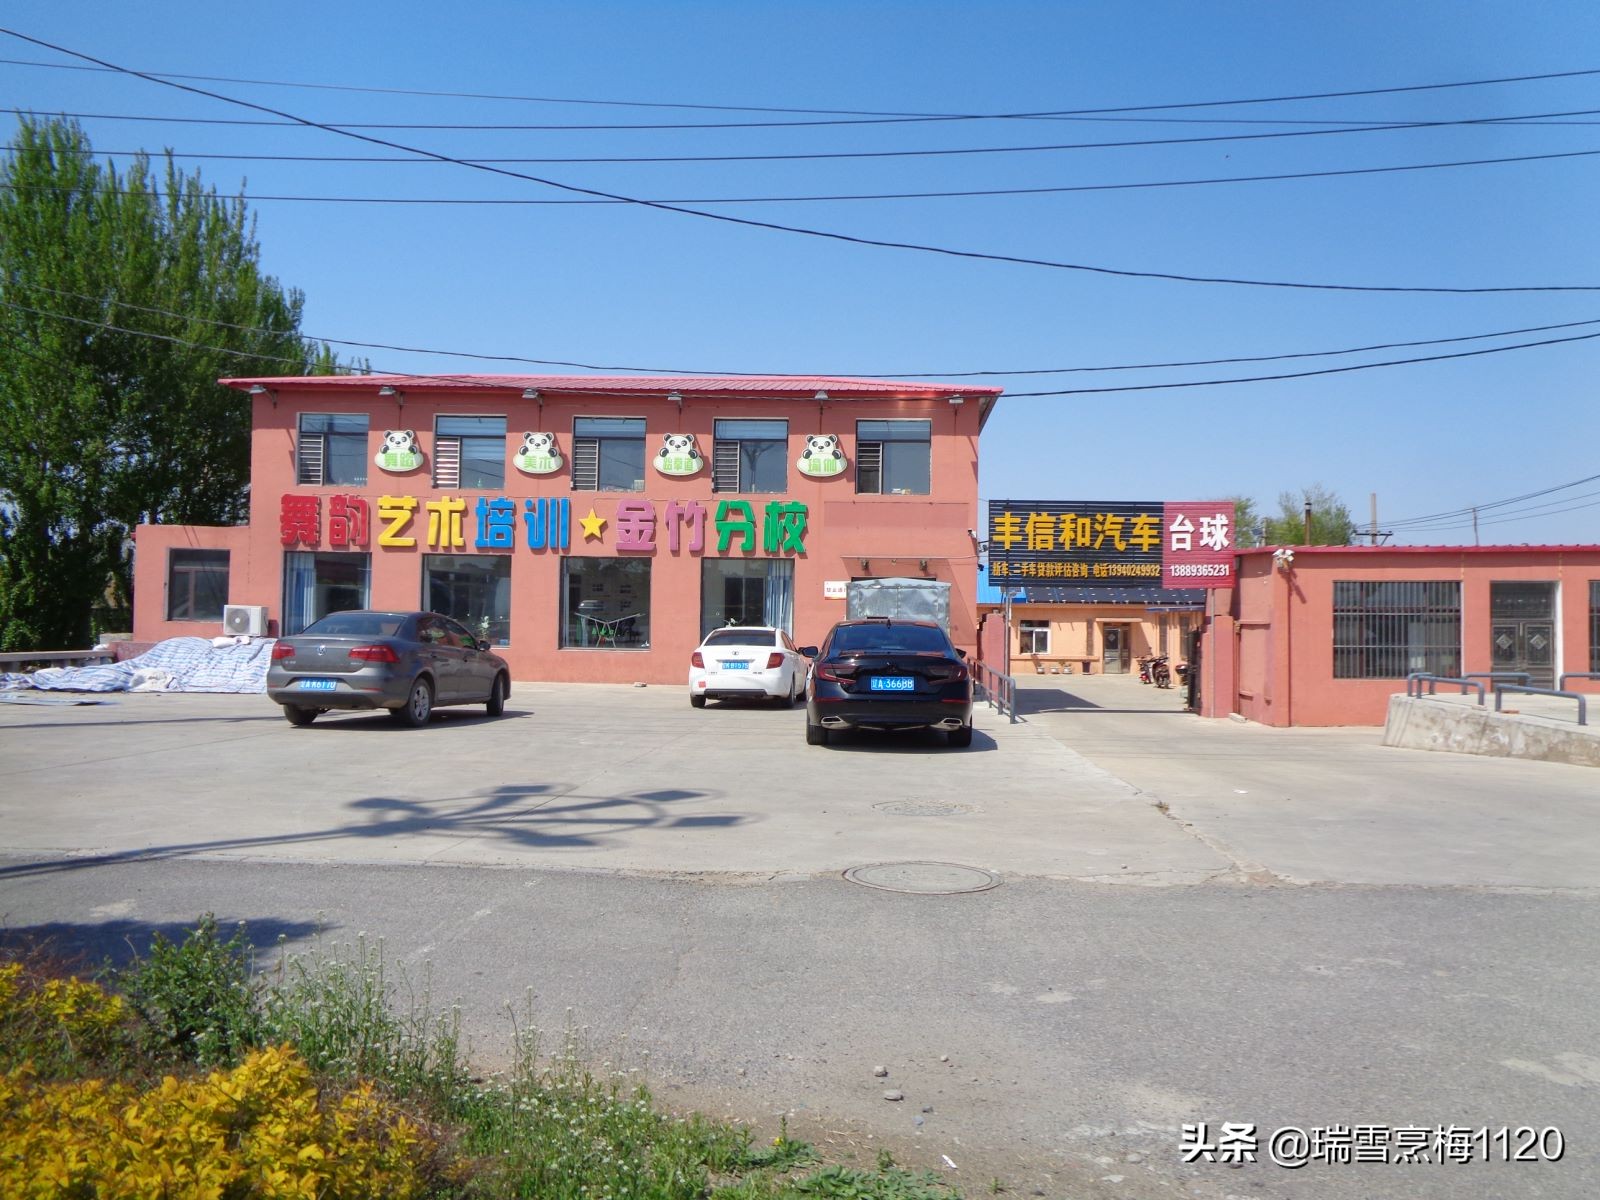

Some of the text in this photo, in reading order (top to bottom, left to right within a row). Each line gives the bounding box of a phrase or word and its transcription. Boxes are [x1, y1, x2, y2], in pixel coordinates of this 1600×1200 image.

[523, 455, 553, 470] 美术
[616, 499, 807, 553] 金竹分校
[992, 511, 1161, 552] 丰信和汽车
[1169, 513, 1229, 551] 台球
[1170, 564, 1230, 577] 13889365231
